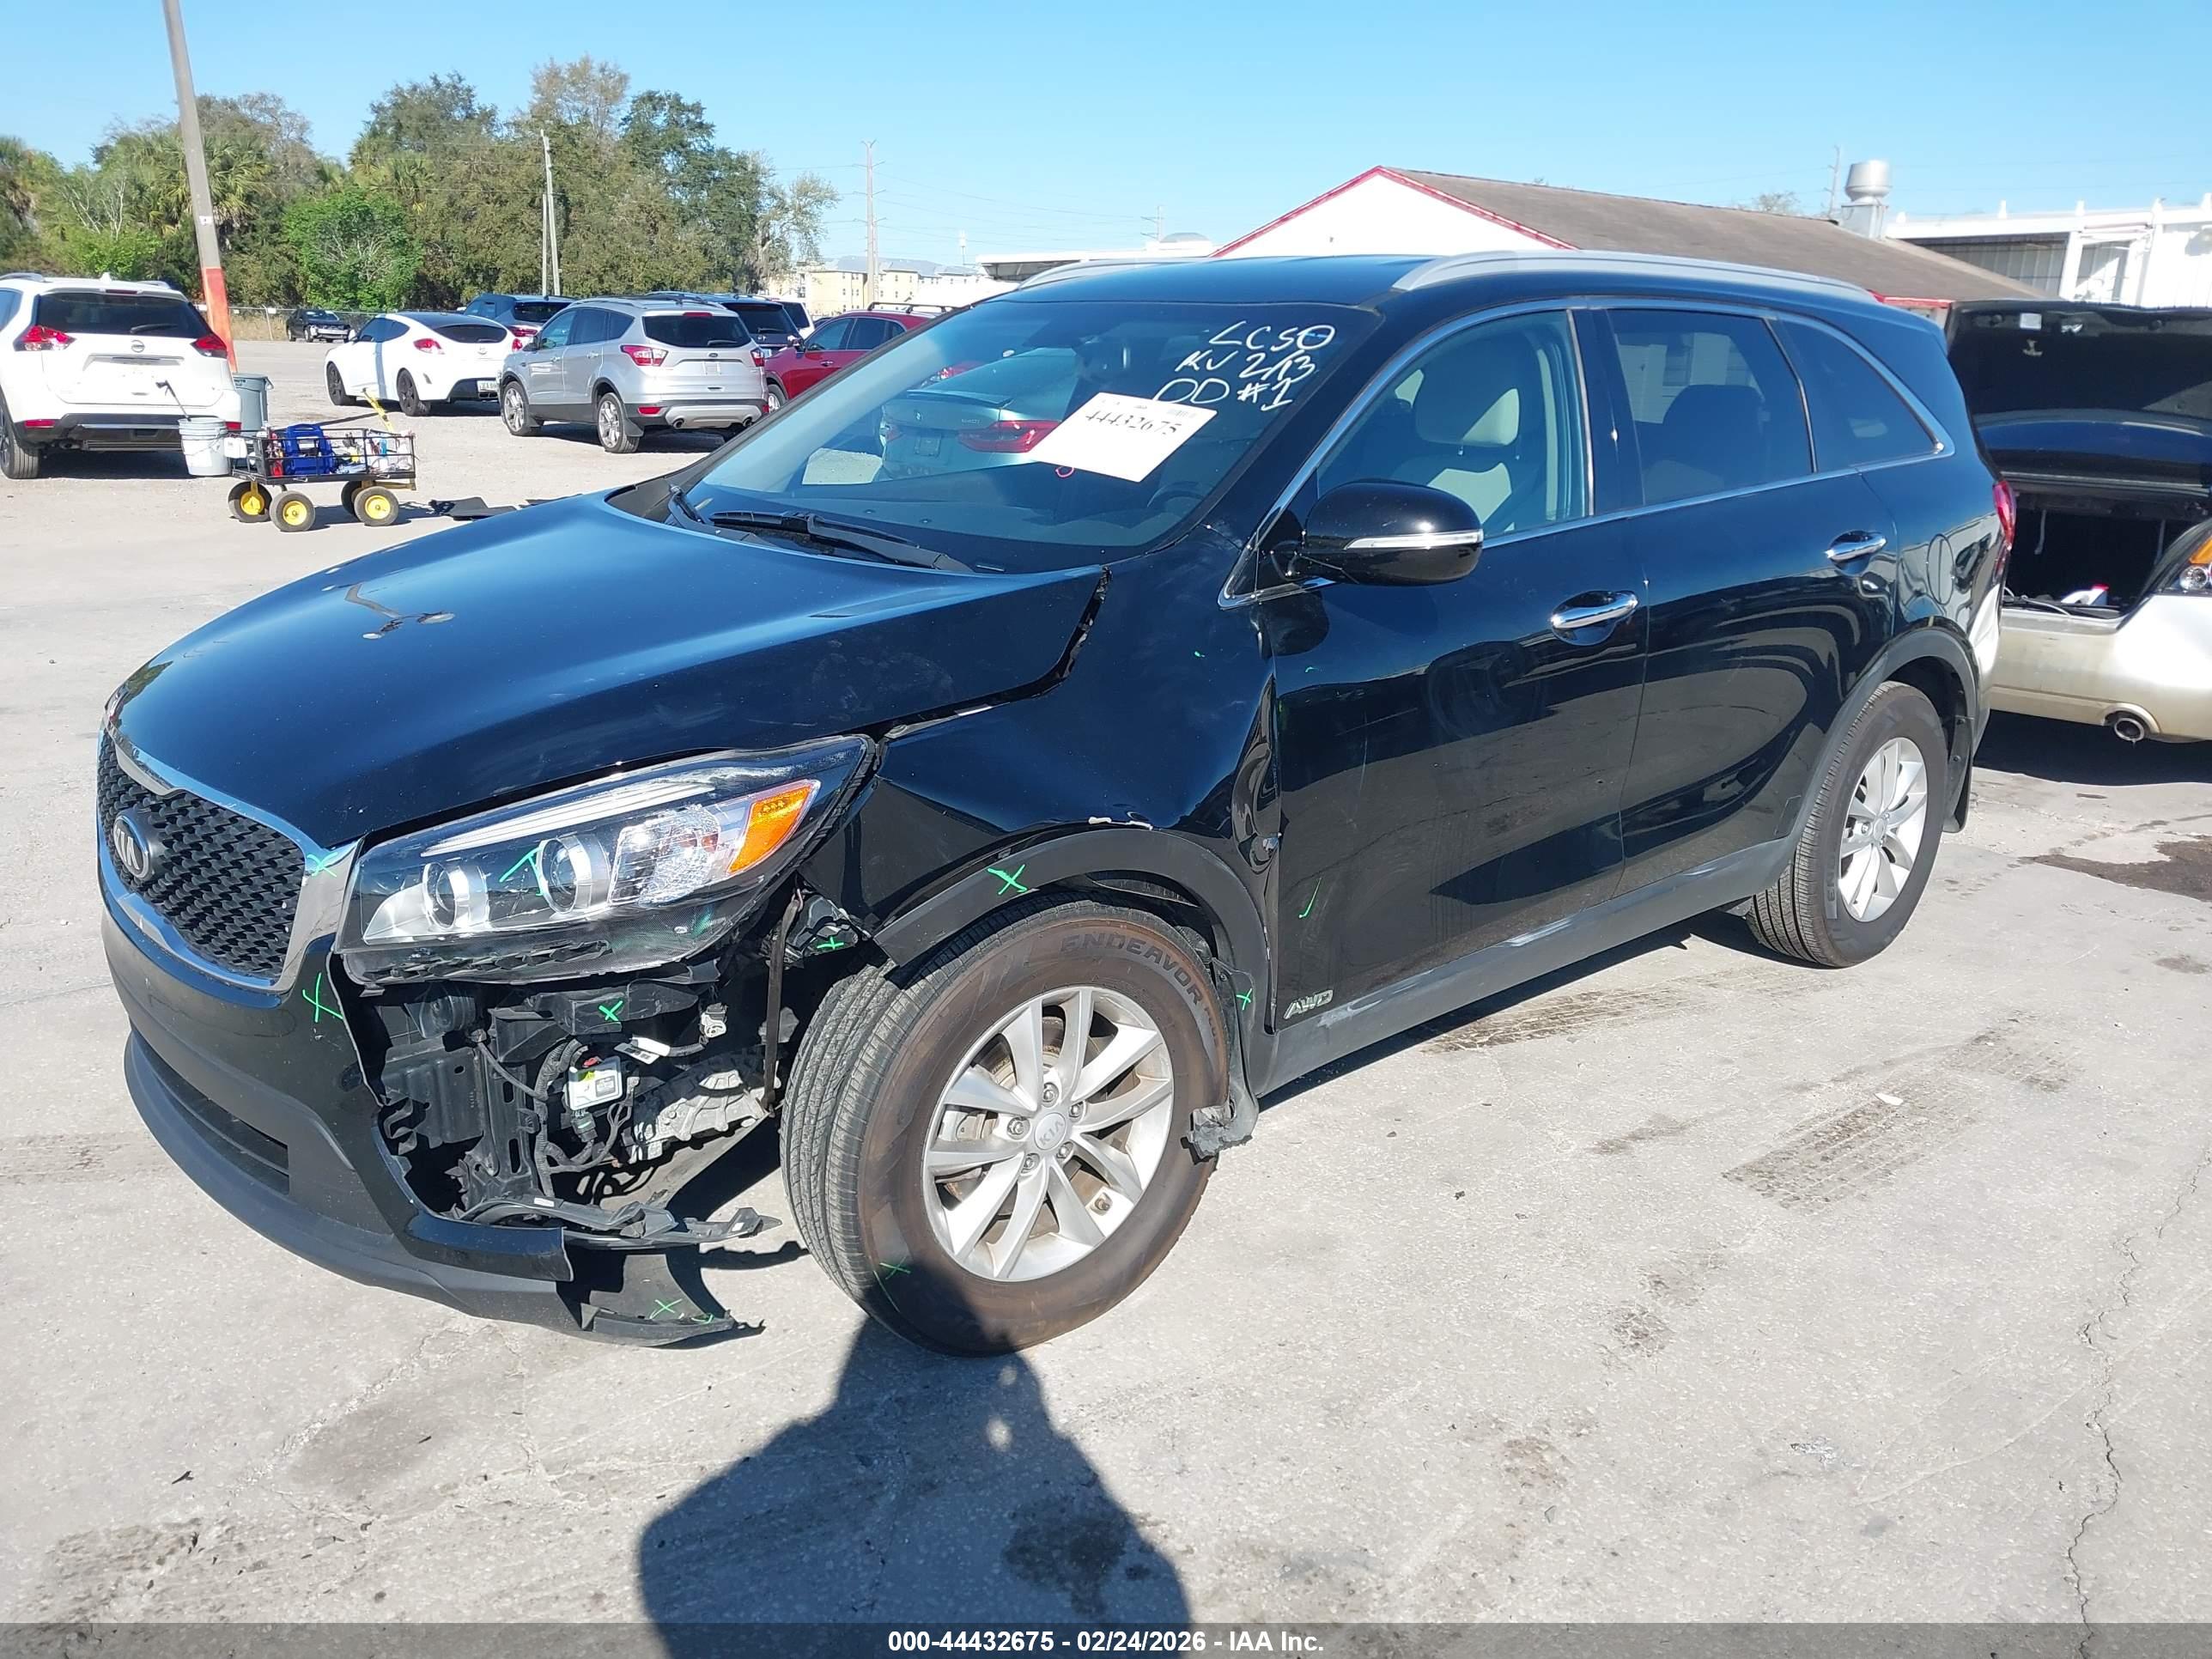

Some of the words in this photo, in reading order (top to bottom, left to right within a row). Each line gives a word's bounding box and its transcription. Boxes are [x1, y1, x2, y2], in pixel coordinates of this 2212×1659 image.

[1208, 320, 1335, 352] LCSO
[1060, 932, 1203, 1006] ENDEAVOR
[1283, 988, 1334, 1020] AWD
[1039, 1120, 1064, 1146] KIA
